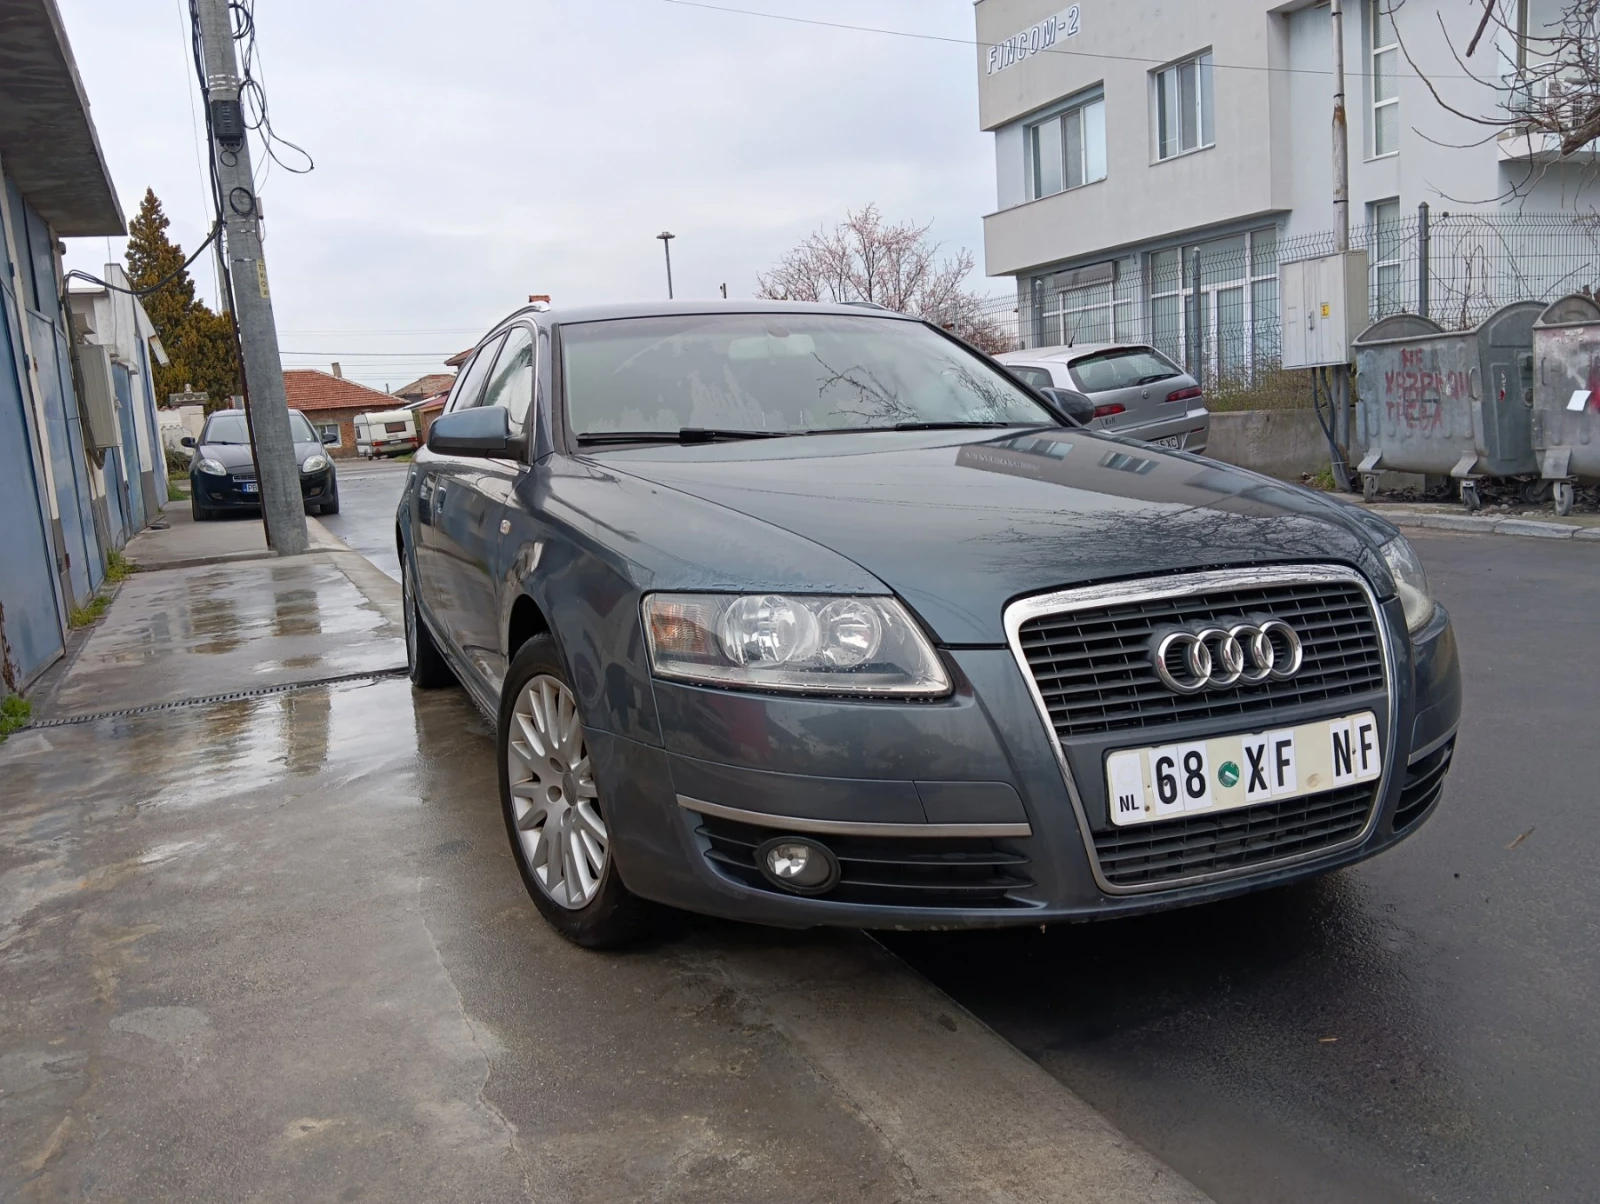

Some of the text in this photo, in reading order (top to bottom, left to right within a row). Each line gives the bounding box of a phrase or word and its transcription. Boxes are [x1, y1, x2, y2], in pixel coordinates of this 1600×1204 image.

[988, 5, 1079, 75] FINCOM-2
[1156, 723, 1373, 804] 68 XF NF
[1119, 794, 1140, 812] NL
